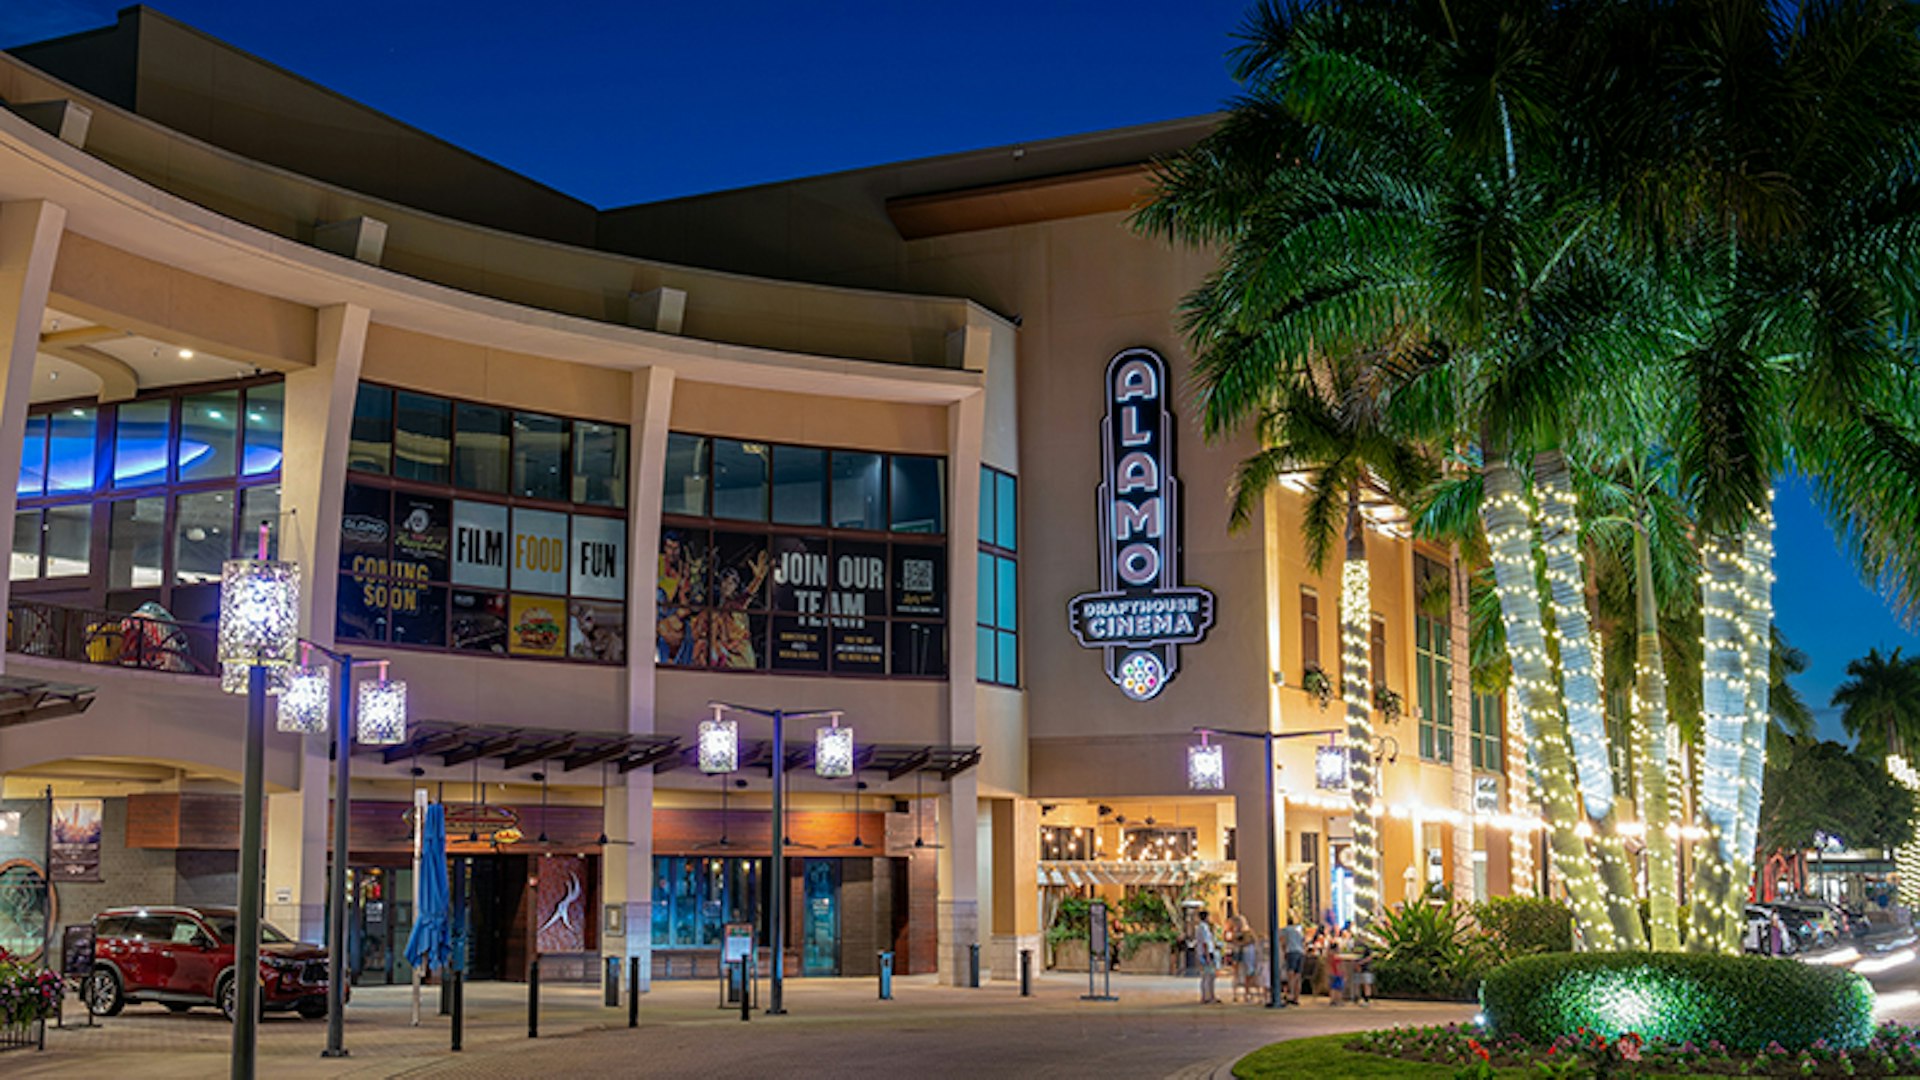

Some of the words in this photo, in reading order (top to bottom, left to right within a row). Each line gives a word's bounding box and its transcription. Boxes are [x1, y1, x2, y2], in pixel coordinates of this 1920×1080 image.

[1115, 360, 1161, 585] ALAMO
[457, 527, 503, 566] FILM
[516, 534, 563, 573] FOOD
[581, 541, 616, 578] FUN
[353, 555, 428, 590] COMING
[774, 552, 828, 586] JOIN
[838, 555, 884, 590] OUR
[363, 584, 417, 610] SOON
[794, 590, 866, 629] TEAM
[1083, 596, 1199, 618] DRAFTHOUSE
[1087, 613, 1194, 639] CINEMA
